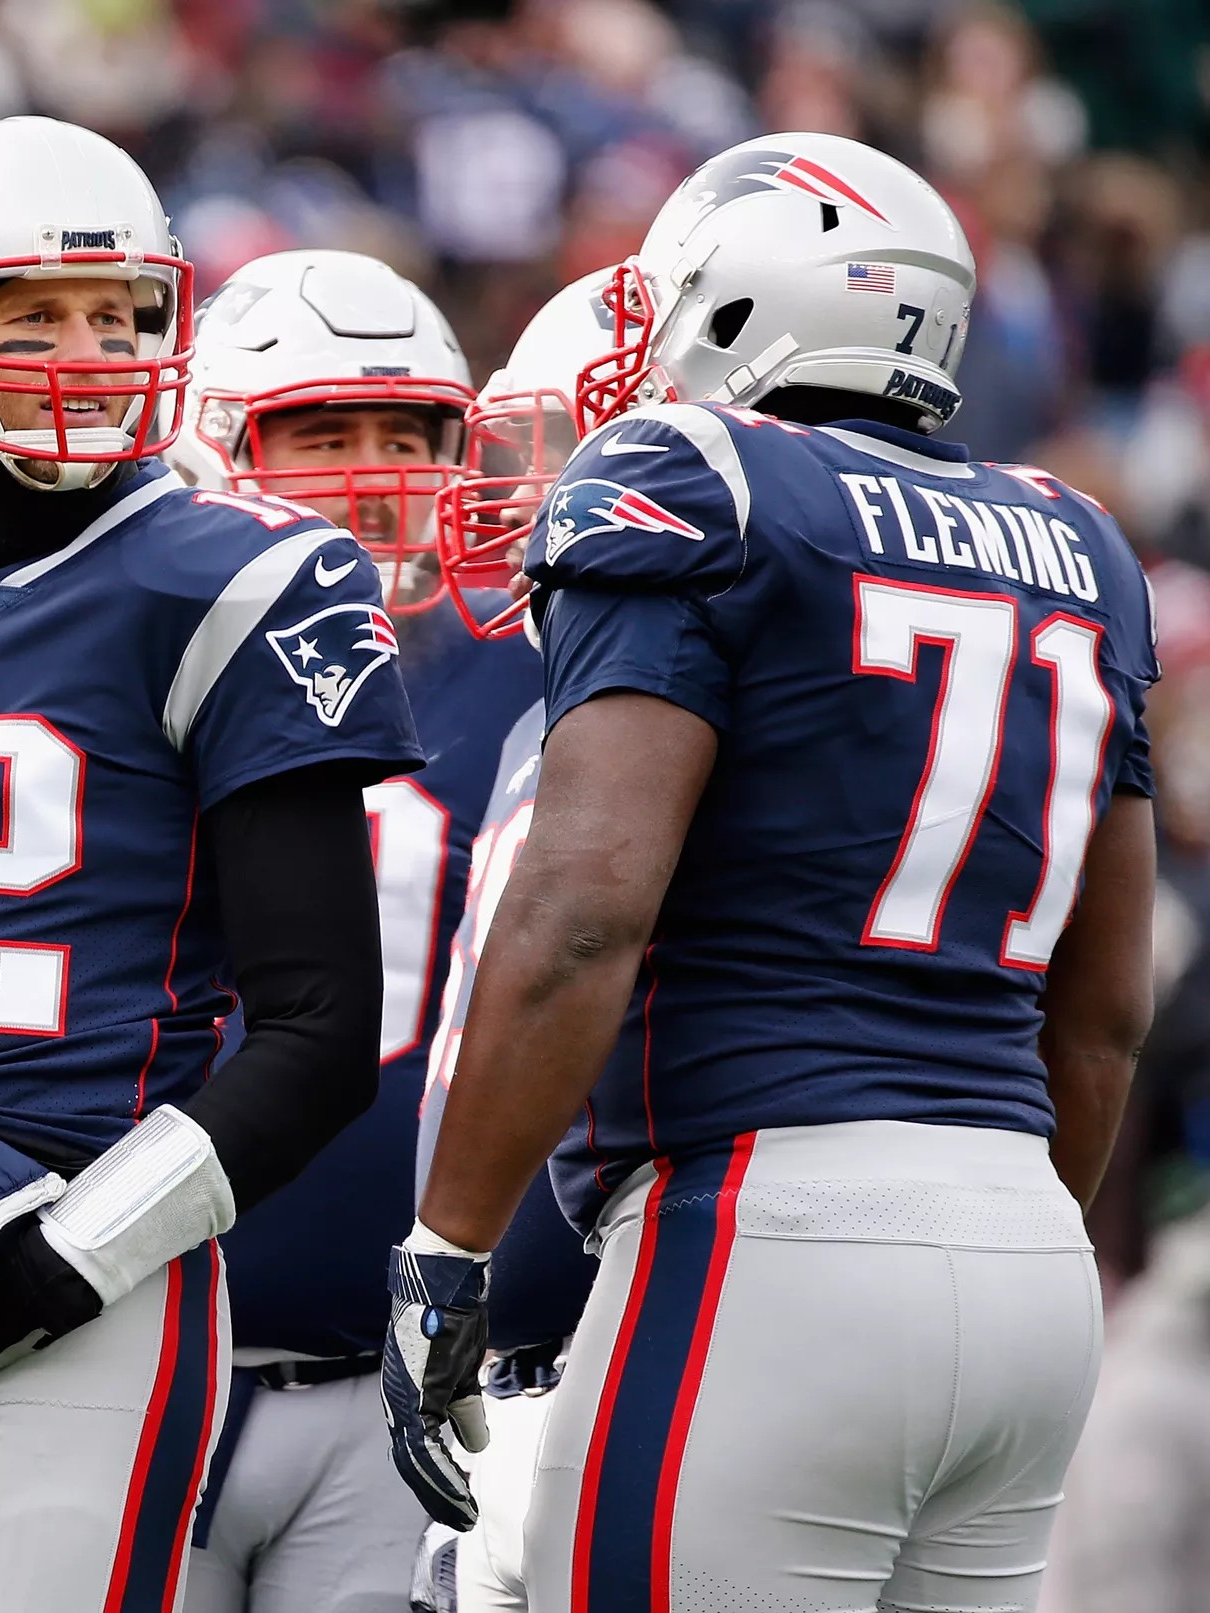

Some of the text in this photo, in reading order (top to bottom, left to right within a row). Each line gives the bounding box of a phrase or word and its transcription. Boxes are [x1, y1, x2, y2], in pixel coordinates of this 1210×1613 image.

[61, 230, 116, 251] PATRIOTS
[895, 303, 925, 355] 7
[839, 473, 1099, 603] FLEMING
[852, 572, 1115, 972] 71
